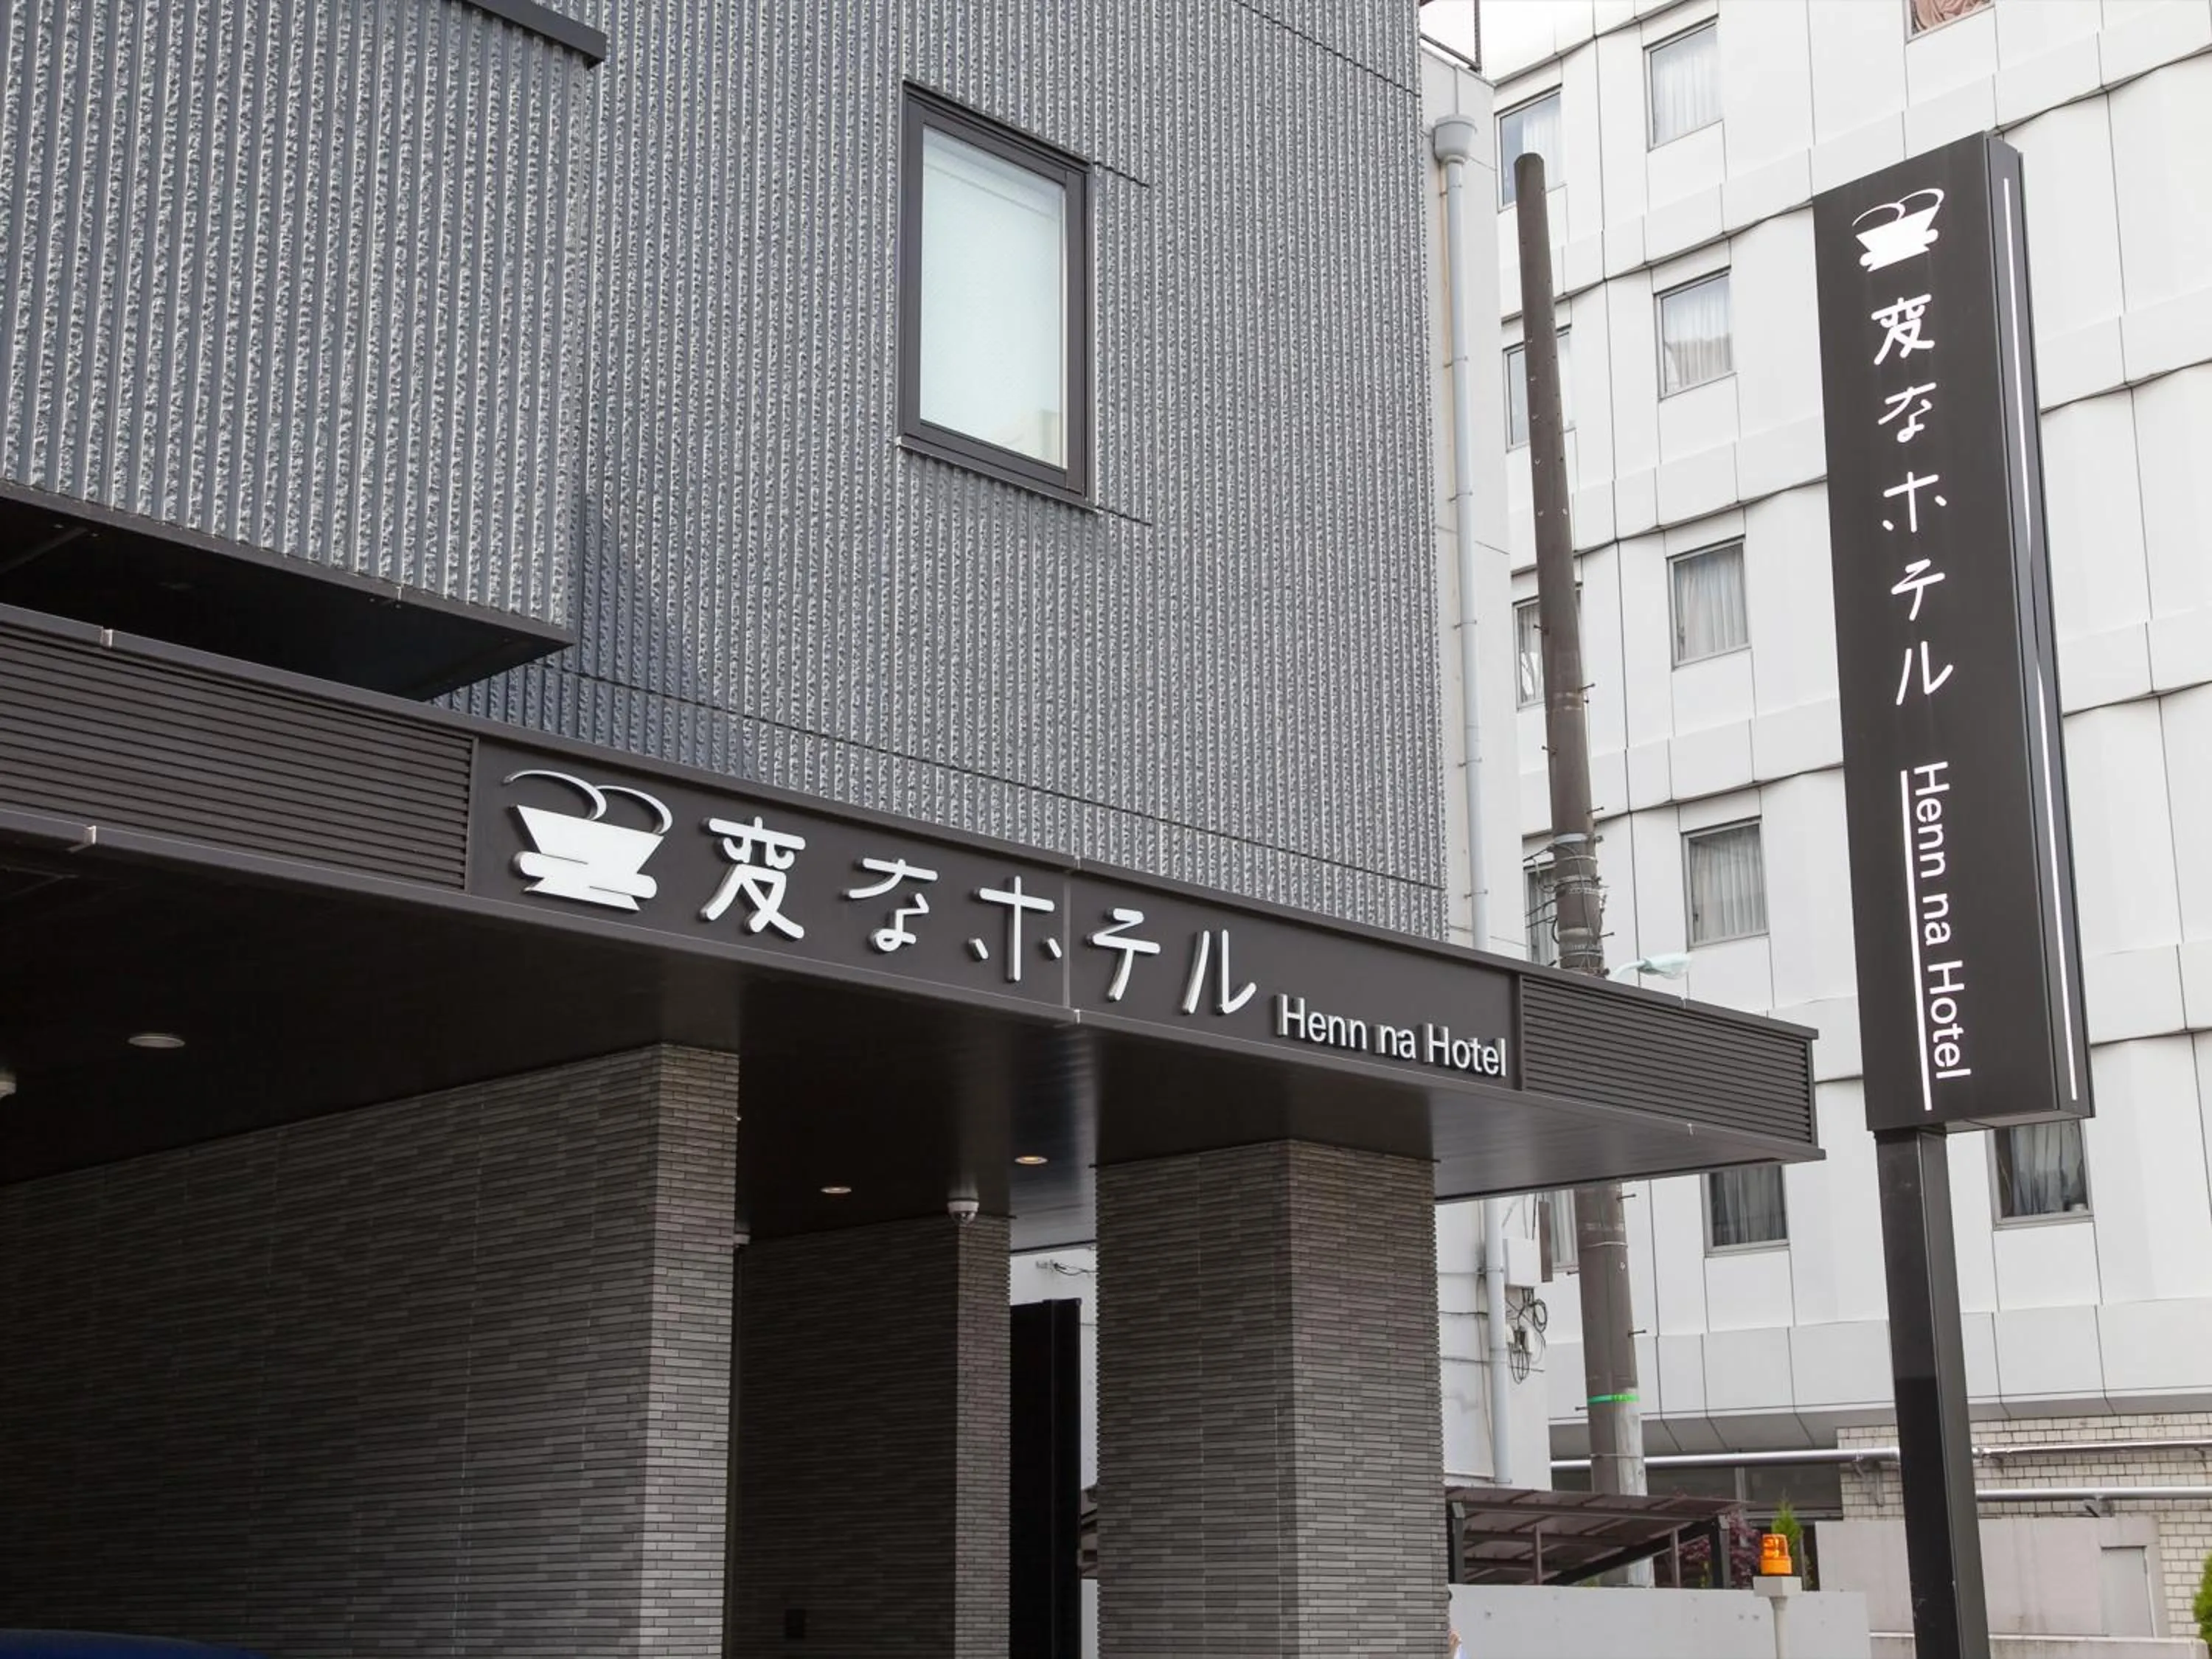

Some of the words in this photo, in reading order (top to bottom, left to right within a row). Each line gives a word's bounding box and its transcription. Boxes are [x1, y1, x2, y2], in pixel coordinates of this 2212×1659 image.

[1871, 293, 1954, 706] 変なホテル
[1913, 761, 1950, 878] Henn
[701, 816, 1257, 1015] 変なホテル
[1922, 893, 1951, 946] na
[1279, 994, 1367, 1050] Henn
[1377, 1023, 1416, 1059] na
[1423, 1023, 1506, 1077] Hotel
[1927, 960, 1972, 1079] Hotel
